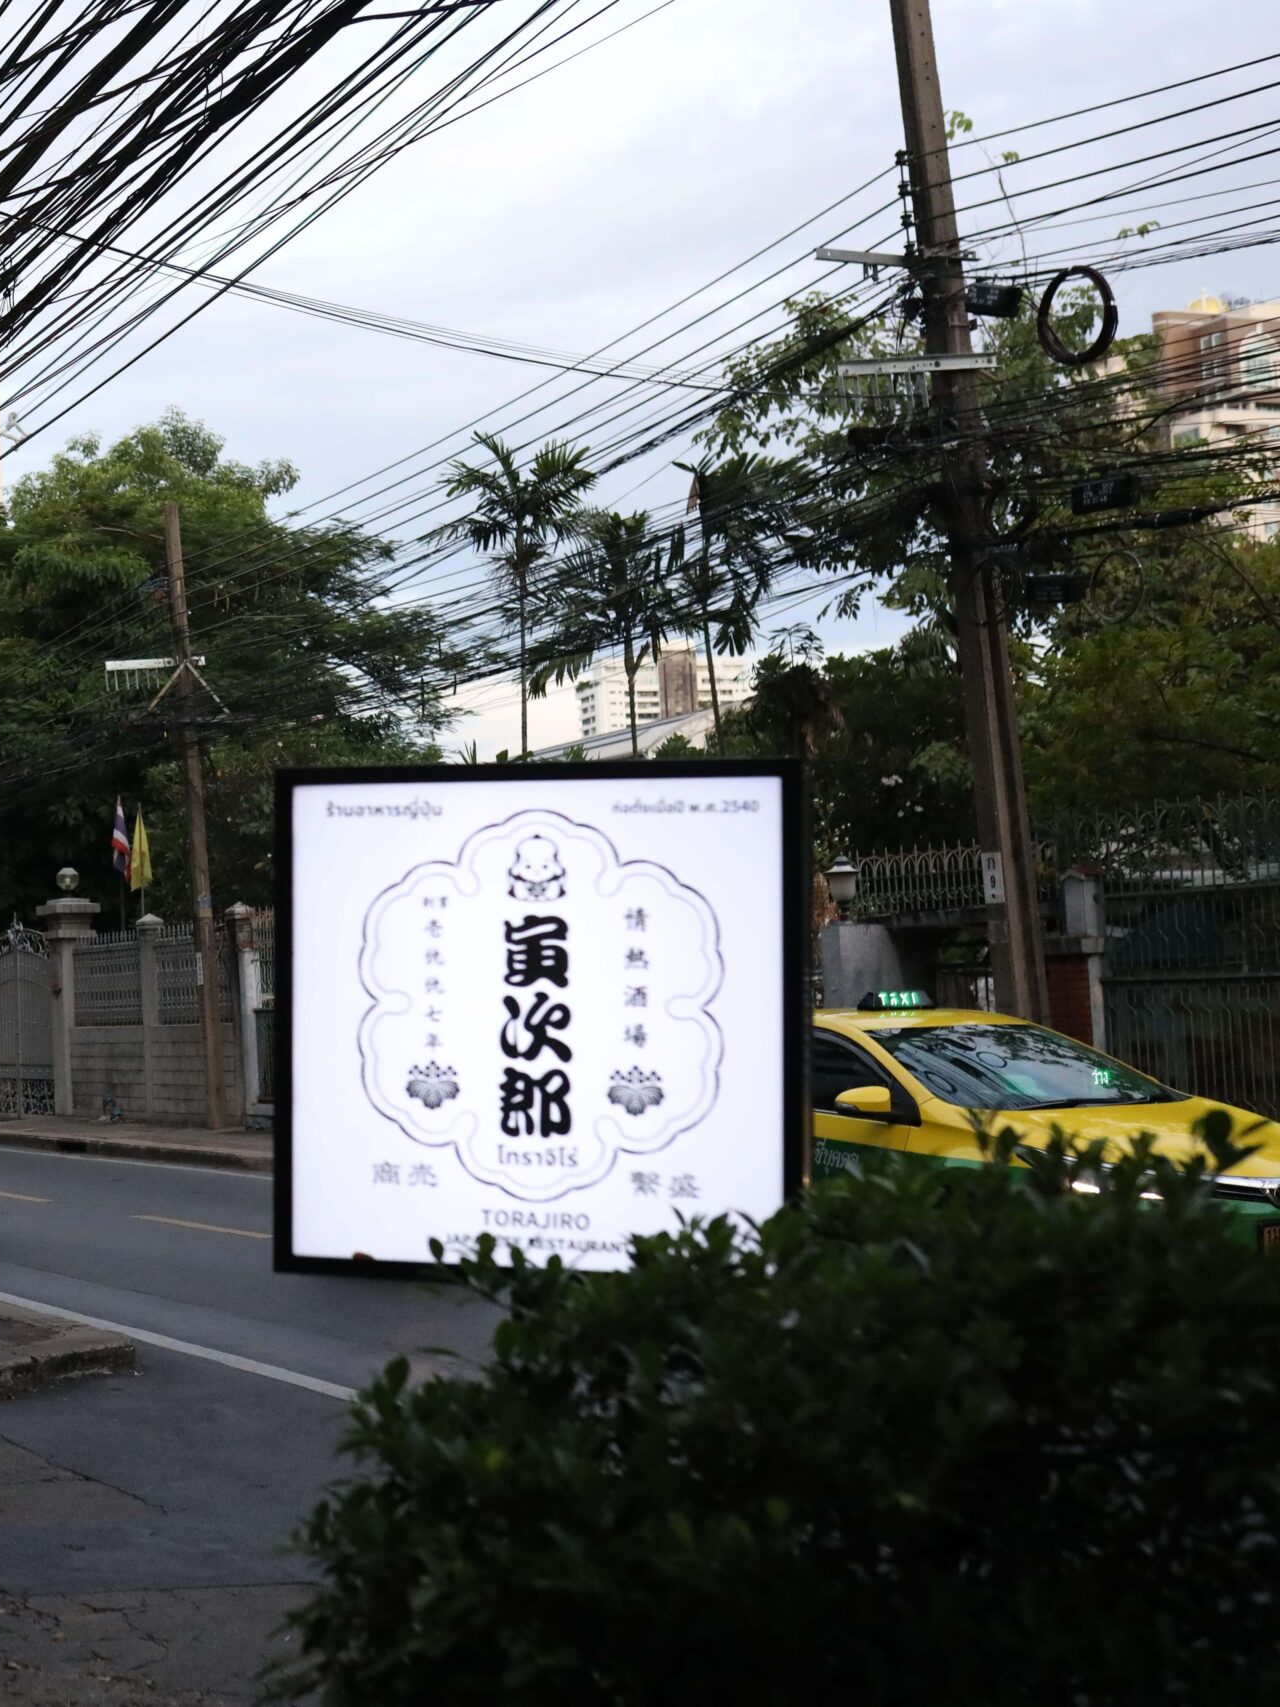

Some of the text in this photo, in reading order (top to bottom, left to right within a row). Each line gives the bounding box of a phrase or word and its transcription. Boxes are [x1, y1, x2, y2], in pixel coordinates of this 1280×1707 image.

[325, 796, 443, 821] ร้านอาหารญี่ปุ่น
[877, 991, 917, 1007] TAXI
[499, 914, 573, 1138] 寅次郎
[497, 1143, 579, 1168] โทราจิโร่
[480, 1208, 590, 1231] TORAJIRO
